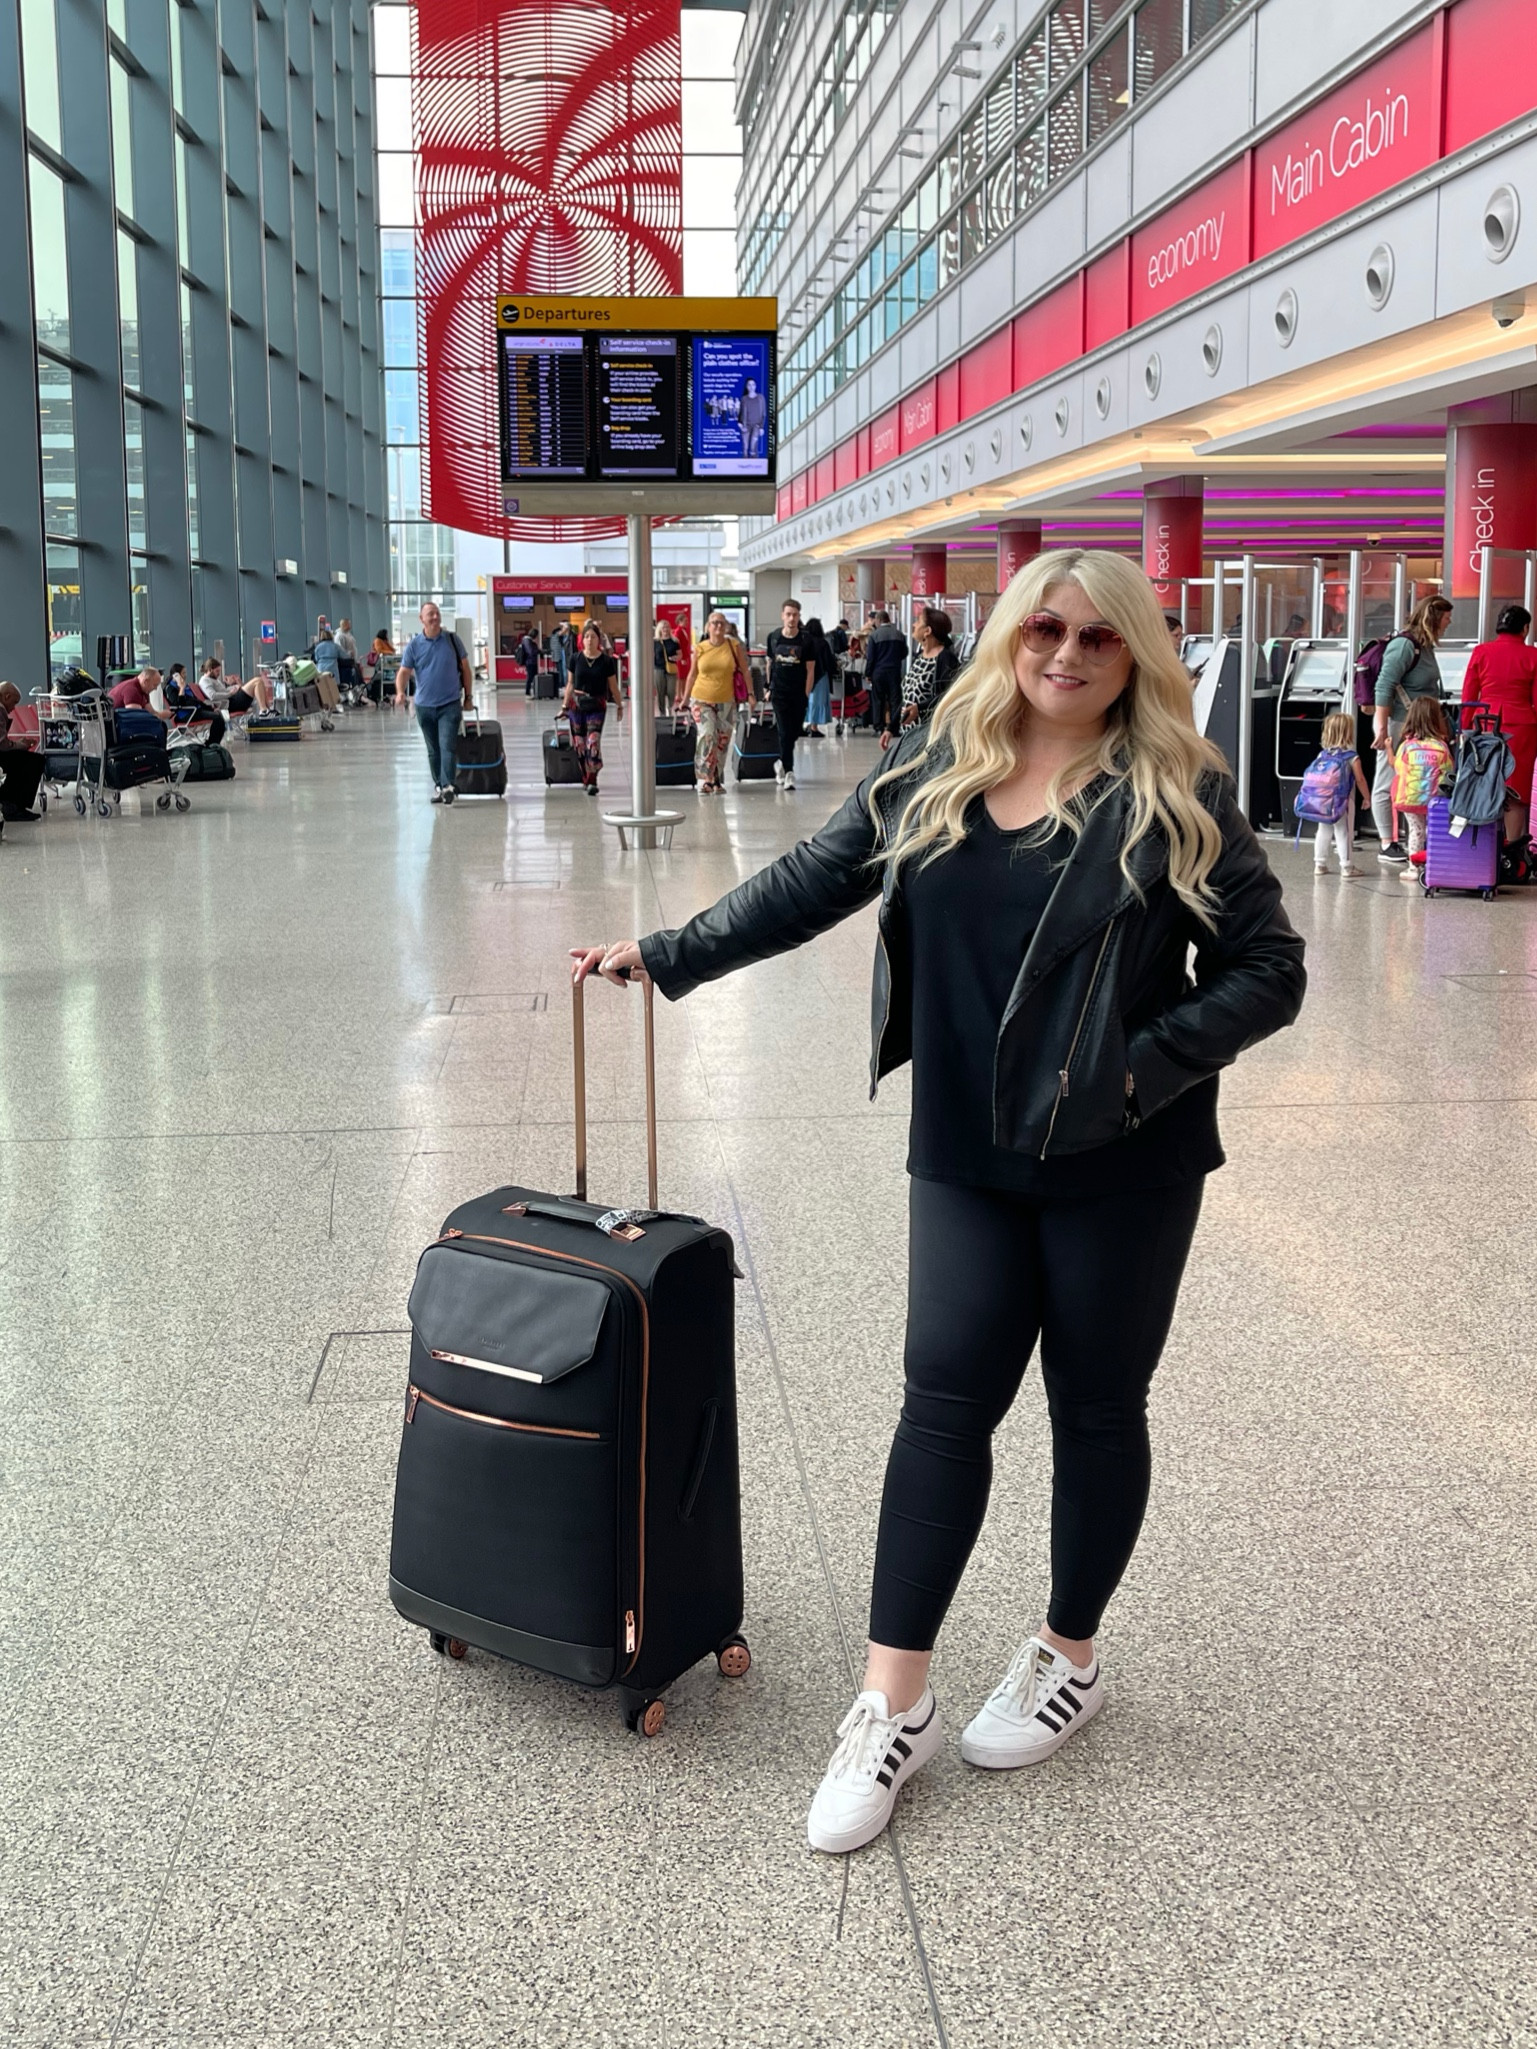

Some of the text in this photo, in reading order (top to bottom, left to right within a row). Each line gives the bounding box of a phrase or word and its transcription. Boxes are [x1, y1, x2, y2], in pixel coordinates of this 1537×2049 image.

[1271, 87, 1408, 216] Main Cabin
[1148, 211, 1225, 288] economy
[524, 306, 611, 323] Departures
[1472, 468, 1495, 489] in
[1155, 525, 1170, 539] in
[496, 581, 572, 590] Customer Service
